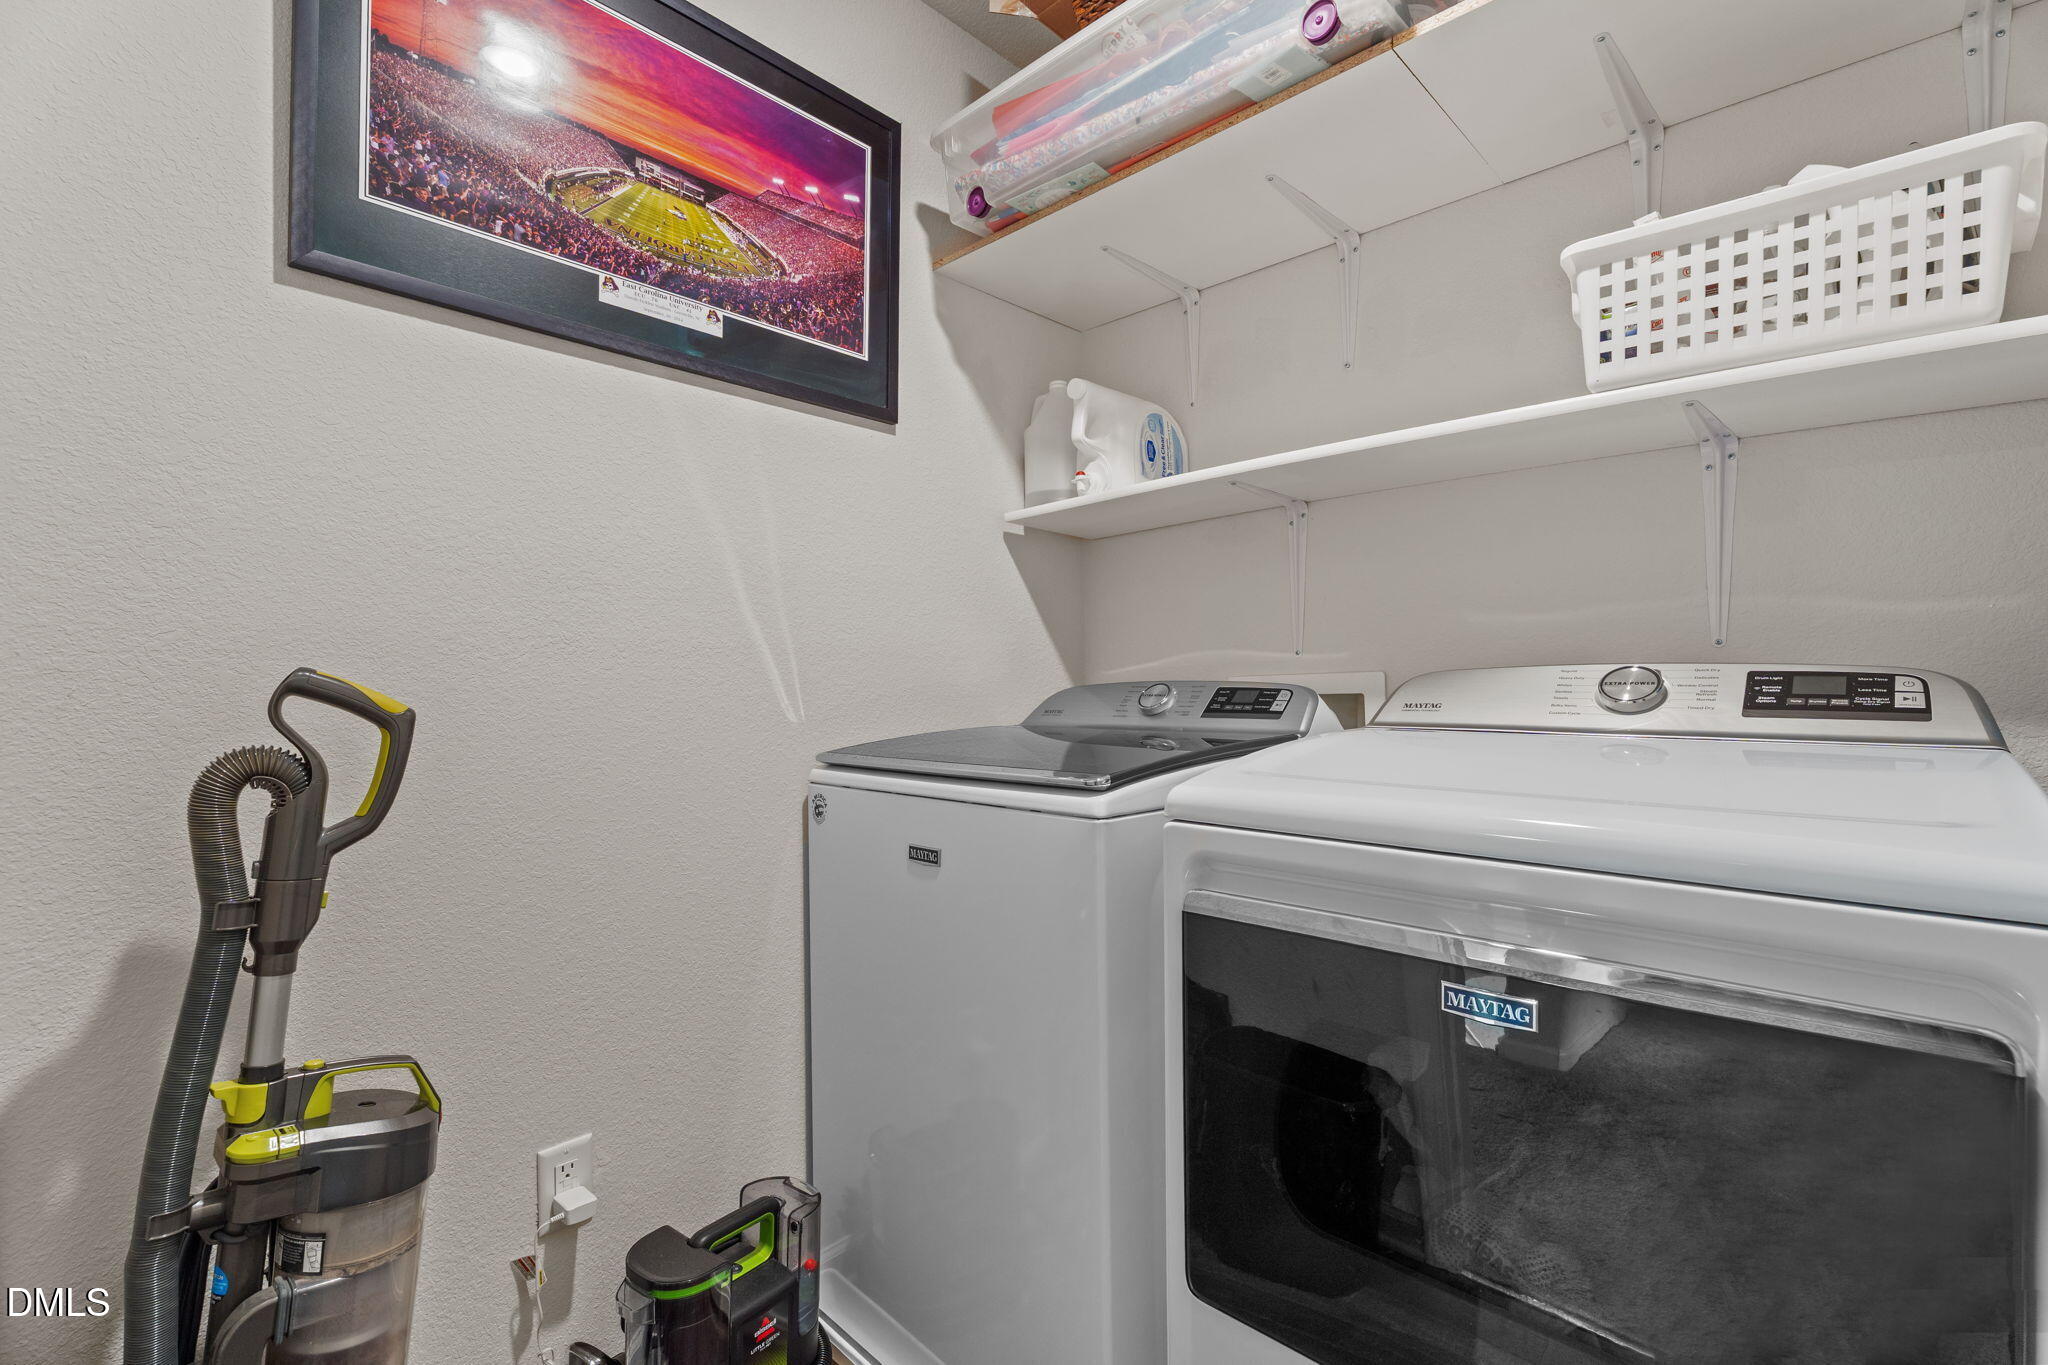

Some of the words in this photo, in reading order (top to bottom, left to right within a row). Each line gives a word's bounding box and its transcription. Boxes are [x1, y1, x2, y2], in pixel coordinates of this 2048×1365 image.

[622, 281, 638, 292] East
[638, 285, 668, 301] Carolina
[669, 295, 703, 312] University
[909, 848, 938, 862] MAYTAG
[1446, 990, 1531, 1024] MAYTAG
[750, 1342, 766, 1356] LITTLE
